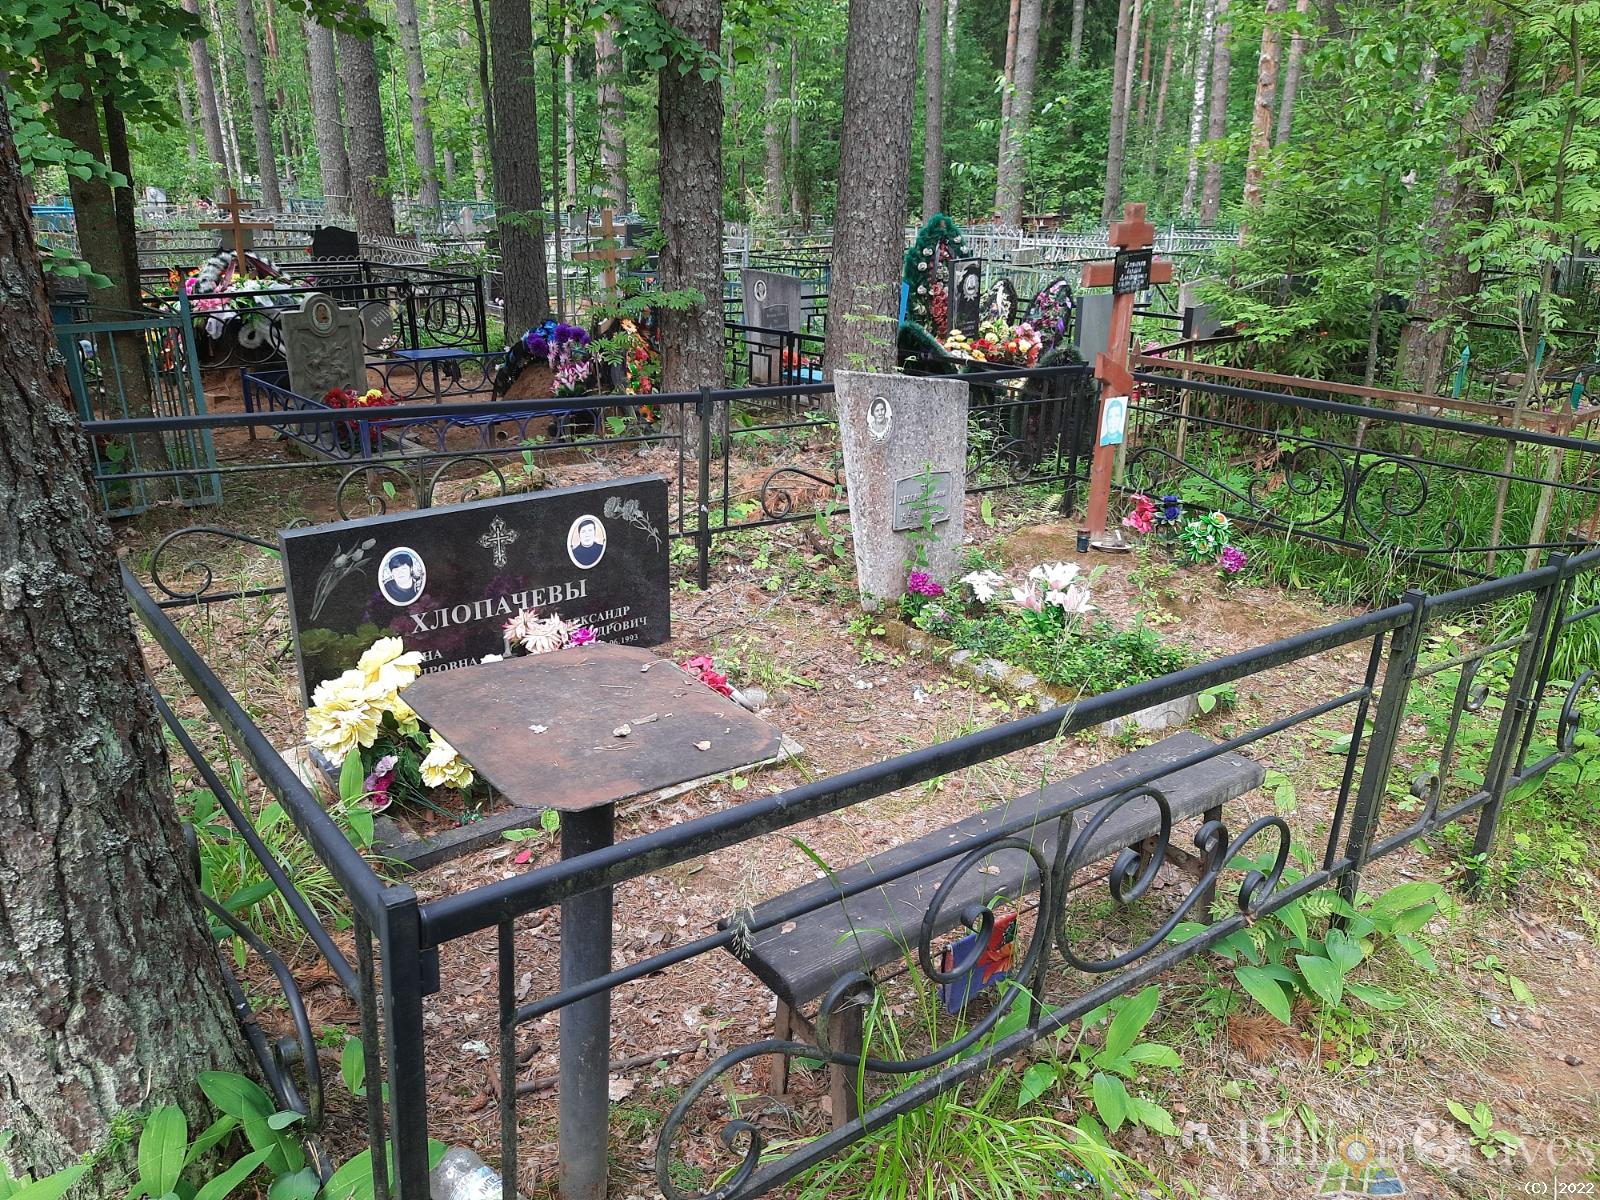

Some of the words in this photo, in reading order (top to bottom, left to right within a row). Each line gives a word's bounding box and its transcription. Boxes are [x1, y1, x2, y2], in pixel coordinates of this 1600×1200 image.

[410, 579, 588, 634] ХЛОПАЧЕВЫ
[597, 616, 647, 637] ДРОВИЧ
[422, 649, 444, 662] НА
